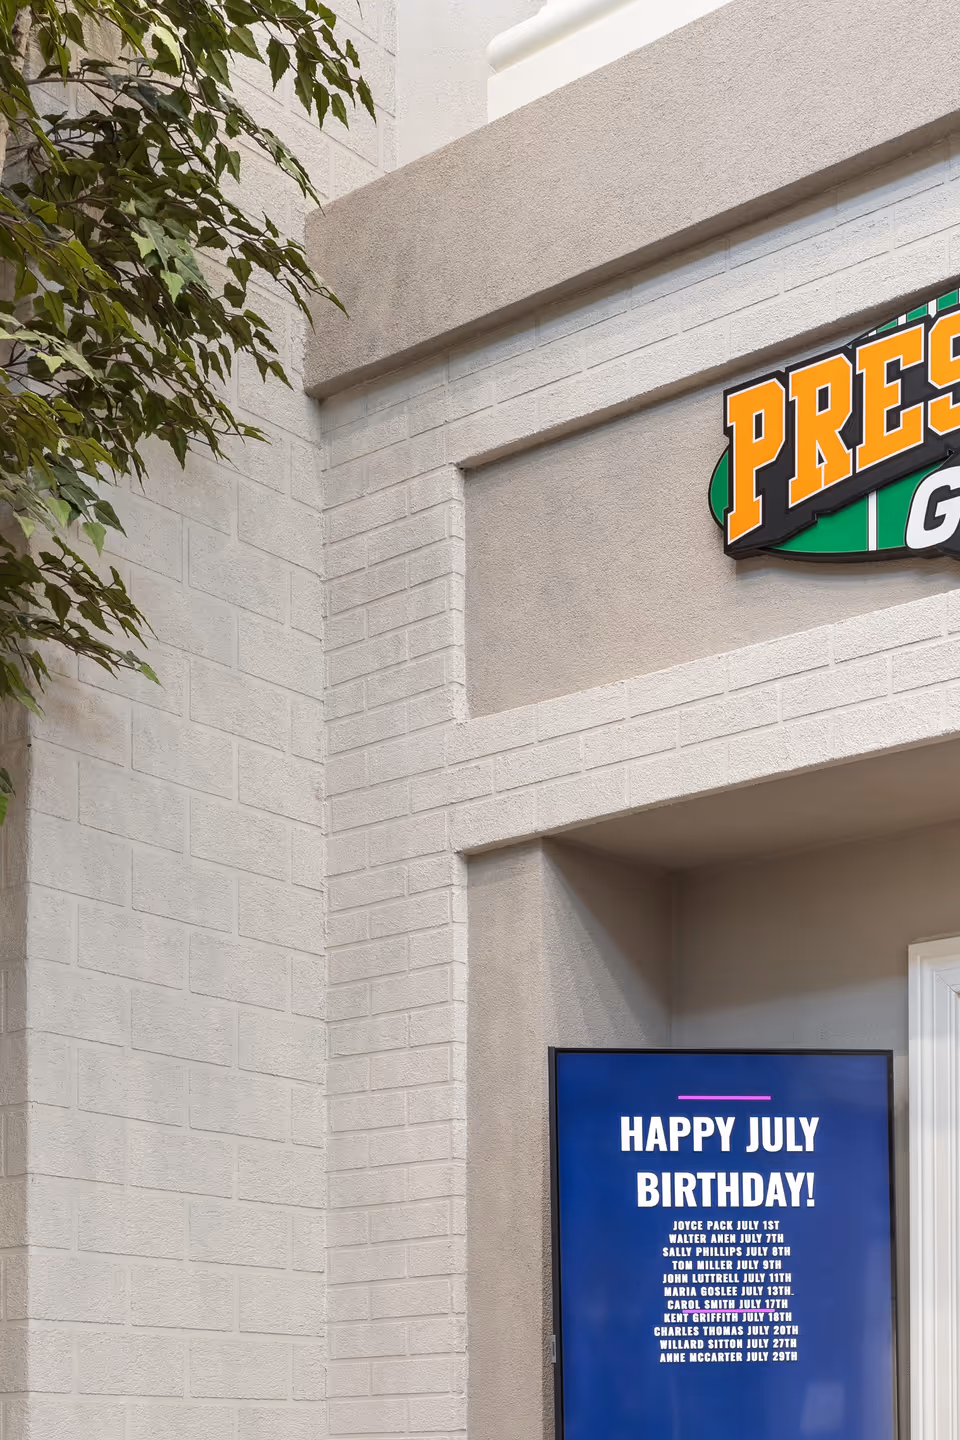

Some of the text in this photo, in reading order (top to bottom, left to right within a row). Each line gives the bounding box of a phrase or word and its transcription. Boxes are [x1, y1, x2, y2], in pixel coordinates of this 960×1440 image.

[620, 1116, 820, 1153] HAPPY JULY
[636, 1171, 815, 1208] BIRTHDAY!
[672, 1220, 780, 1231] JOYCE PACK JULY 1ST
[668, 1233, 707, 1244] WALTER
[739, 1233, 763, 1244] JULY
[765, 1233, 785, 1244] 7TH
[662, 1246, 791, 1257] SALLY PHILLIPS JULY 8TH
[671, 1259, 782, 1271] TOM MILLER JULY 9TH
[662, 1272, 792, 1284] JOHN LUTTRELL JULY 11TH
[663, 1285, 697, 1297] MARIA
[700, 1285, 738, 1297] GOSLEE
[740, 1285, 764, 1297] JULY
[667, 1298, 789, 1310] CAROL SMITH JULY 17TH
[663, 1311, 793, 1323] KENT GRIFFITH JULY 18TH
[653, 1324, 799, 1336] CHARLES THOMAS JULY 20TH
[659, 1338, 798, 1350] WILLARD SITTON JULY 27TH
[659, 1351, 798, 1363] ANNE MCCARTER JULY 29TH
